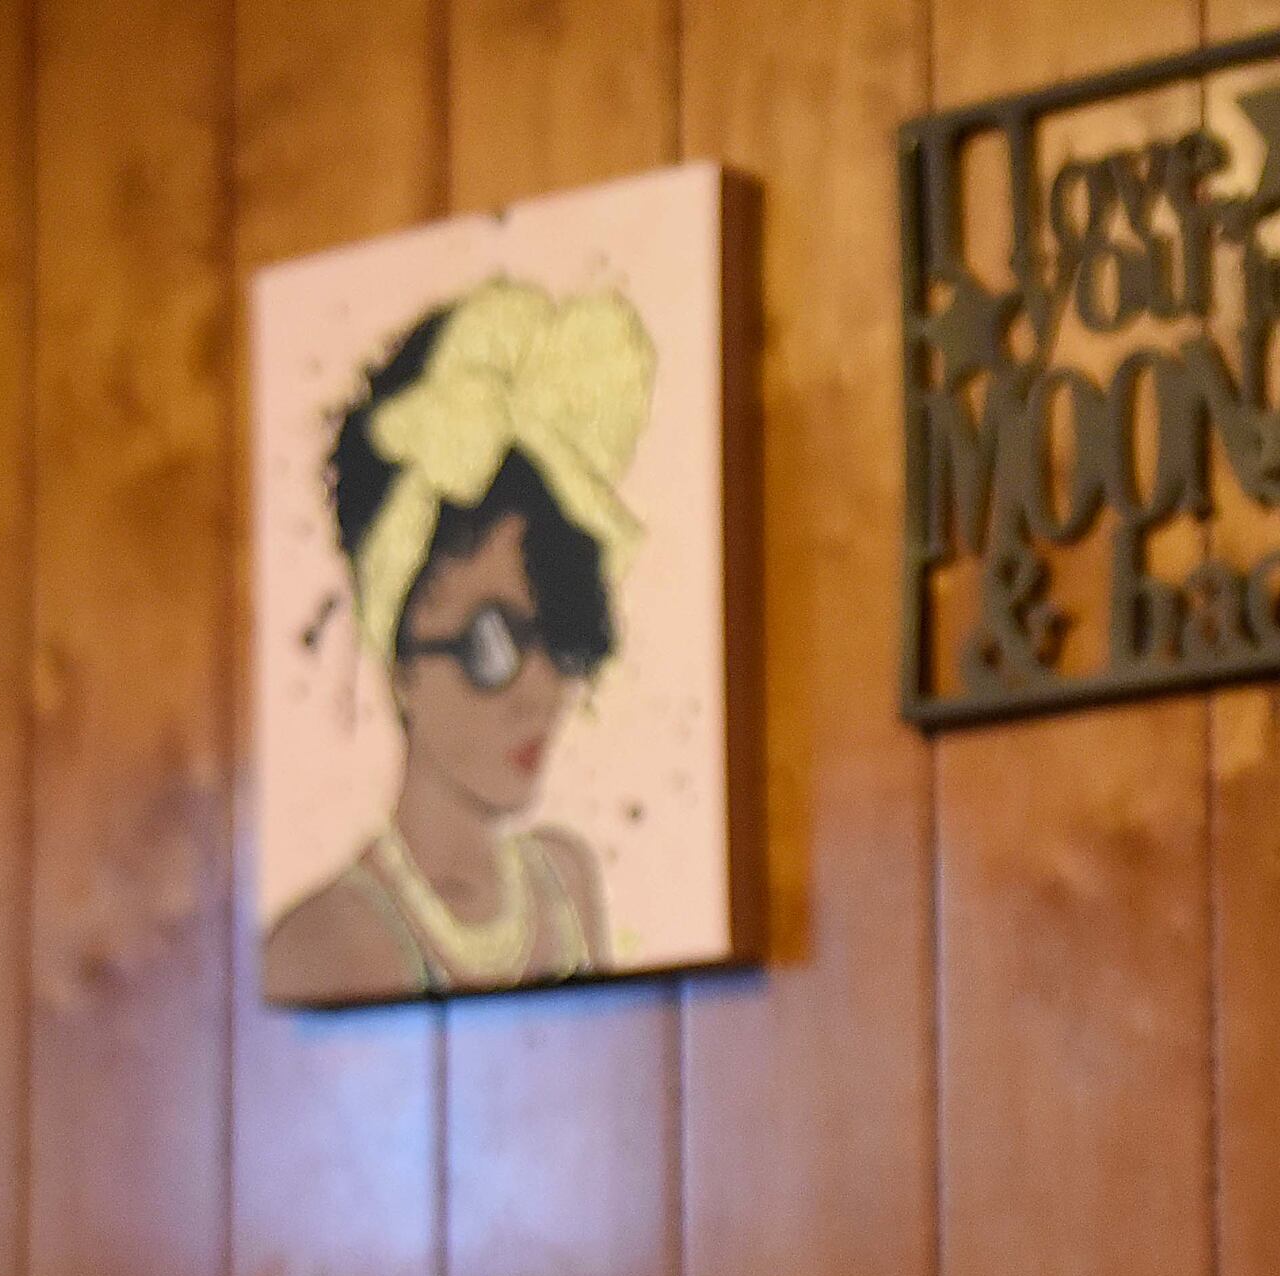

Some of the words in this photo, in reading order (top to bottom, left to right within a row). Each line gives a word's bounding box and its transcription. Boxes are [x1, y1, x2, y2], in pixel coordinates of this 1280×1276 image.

[1005, 95, 1232, 285] love
[1013, 225, 1216, 393] you
[923, 338, 1268, 556] MOON
[957, 545, 1072, 695] &
